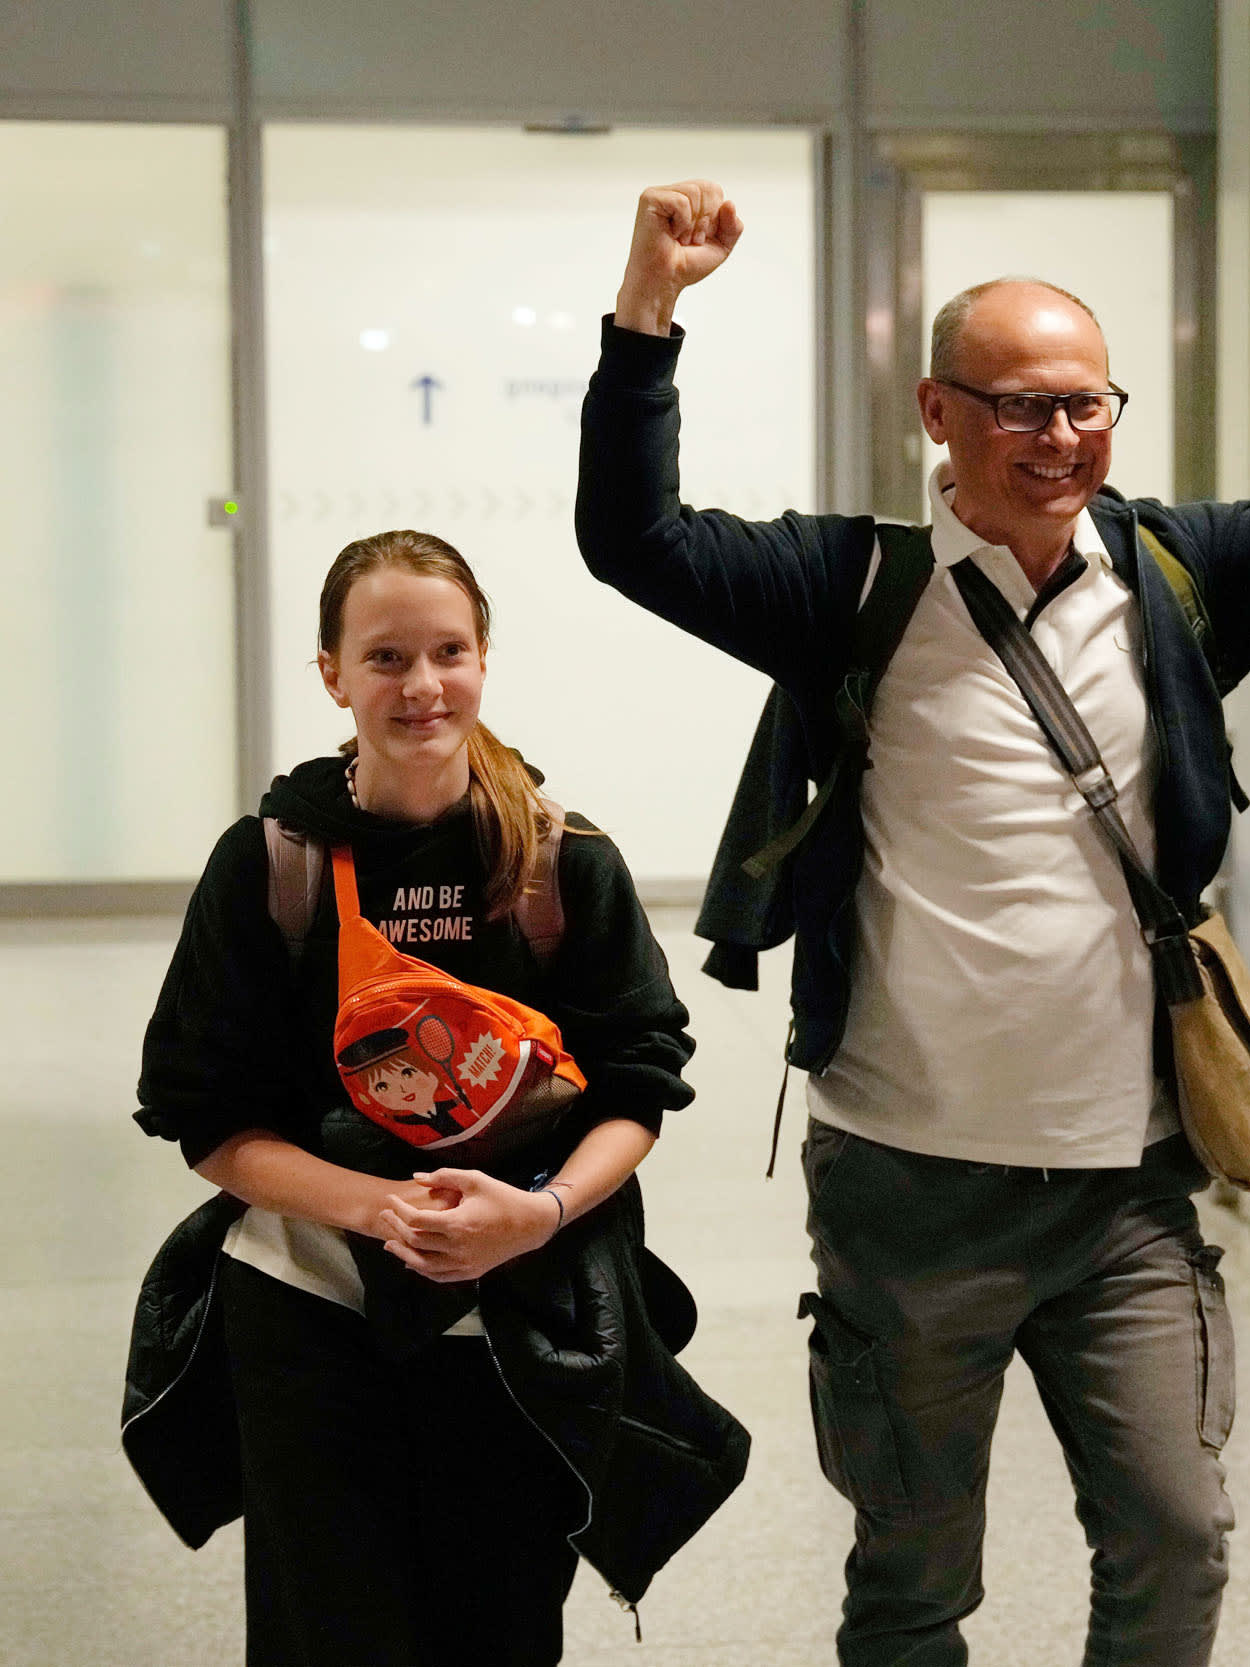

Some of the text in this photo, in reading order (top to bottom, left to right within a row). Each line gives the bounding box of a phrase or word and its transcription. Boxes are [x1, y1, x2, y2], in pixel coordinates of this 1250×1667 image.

[392, 885, 465, 911] AND BE
[378, 916, 473, 943] AWESOME
[467, 1043, 497, 1080] MATCH!
